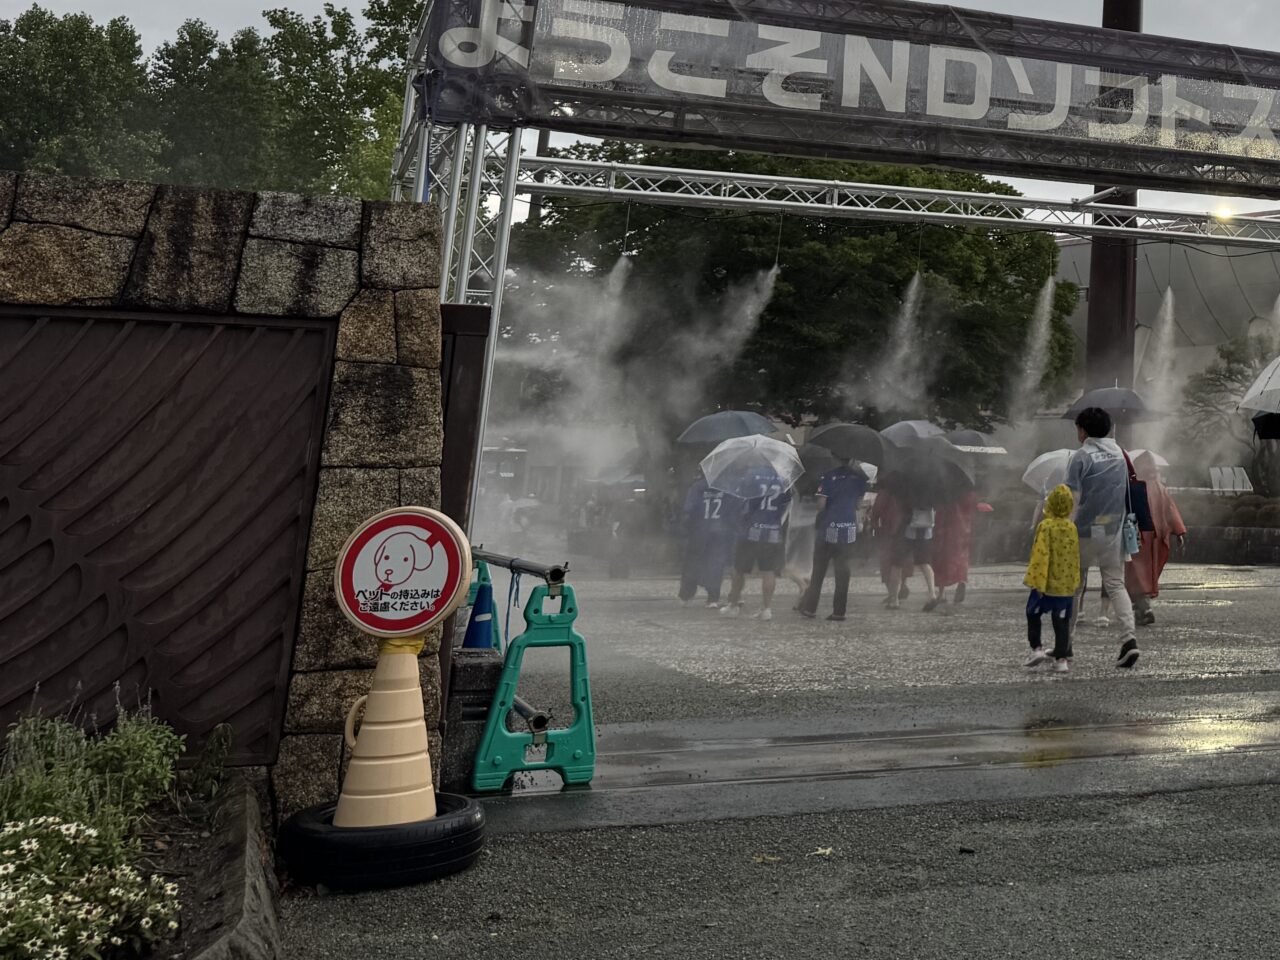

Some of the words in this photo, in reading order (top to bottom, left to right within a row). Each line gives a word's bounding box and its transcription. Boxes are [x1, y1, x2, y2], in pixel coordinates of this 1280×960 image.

[703, 498, 722, 520] 12
[356, 589, 440, 600] ペットの持込みは
[360, 602, 435, 612] ご遠慮ください。
